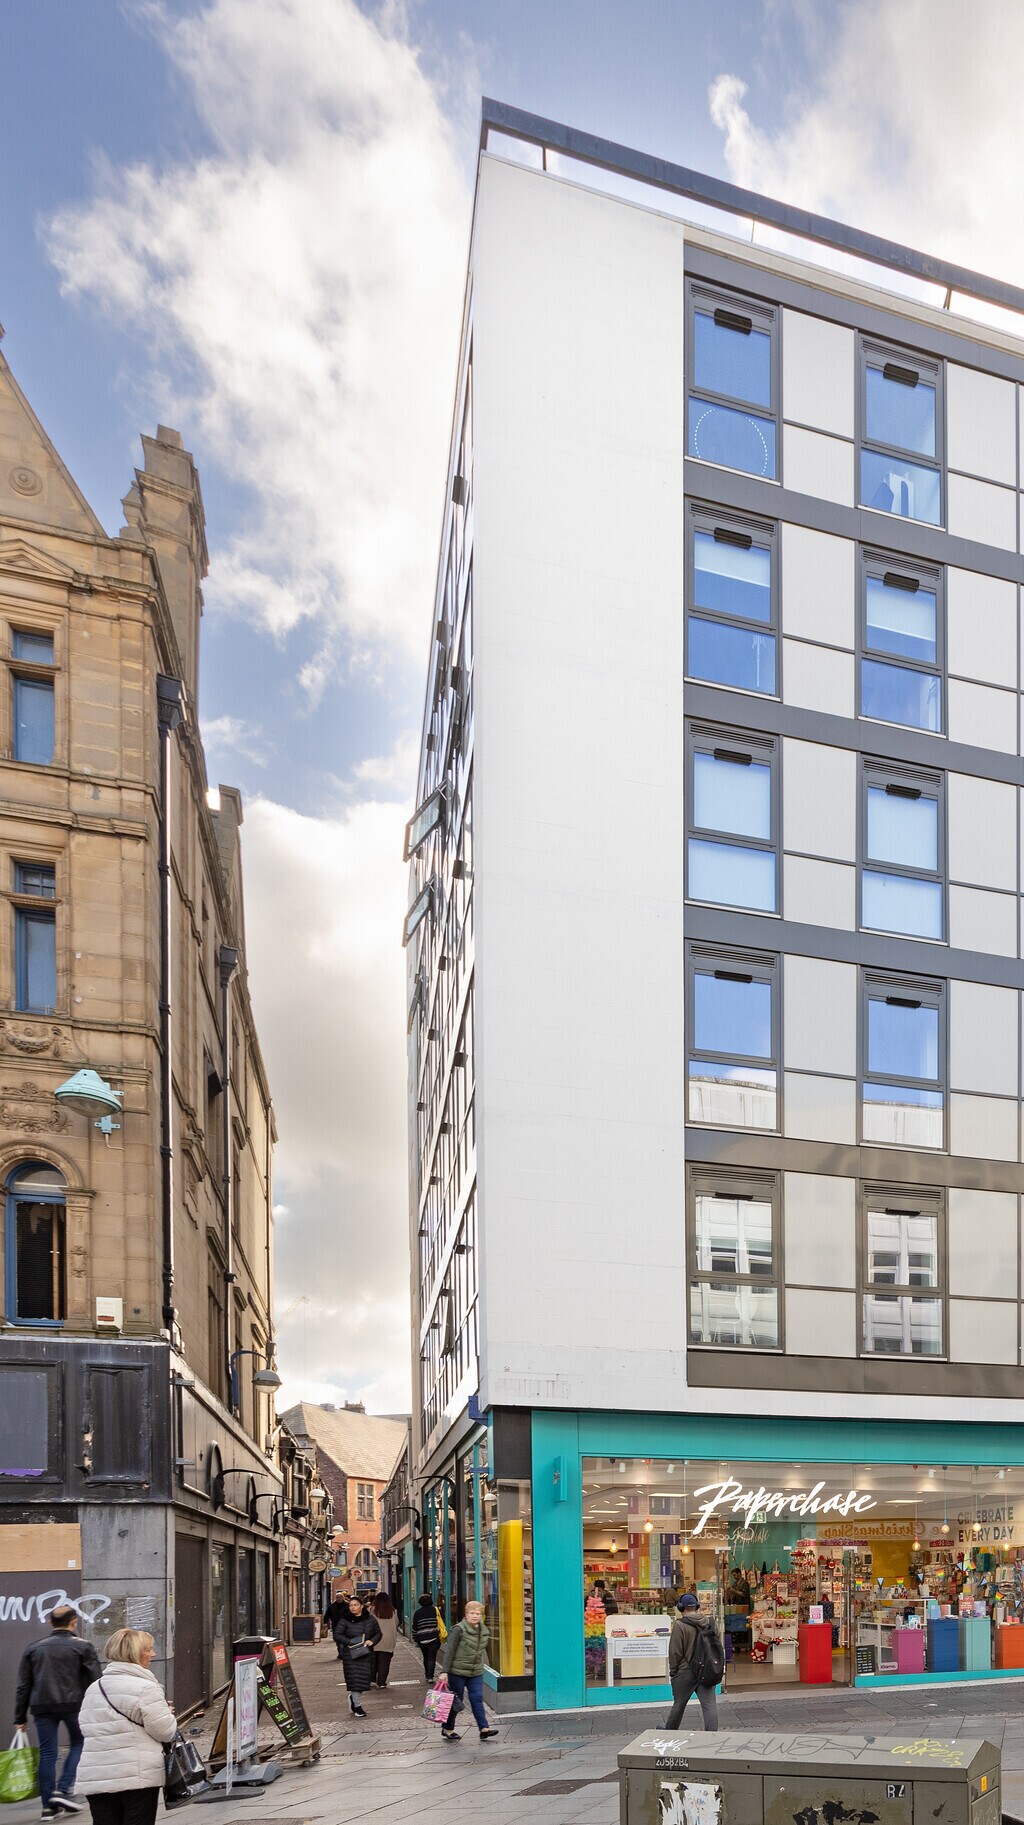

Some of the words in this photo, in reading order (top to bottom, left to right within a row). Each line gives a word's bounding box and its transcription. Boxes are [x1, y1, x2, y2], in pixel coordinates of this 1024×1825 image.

[692, 1475, 877, 1536] Paperchase
[957, 1507, 1014, 1525] CELEBRATE
[958, 1527, 991, 1543] EVERY
[993, 1526, 1014, 1541] DAY
